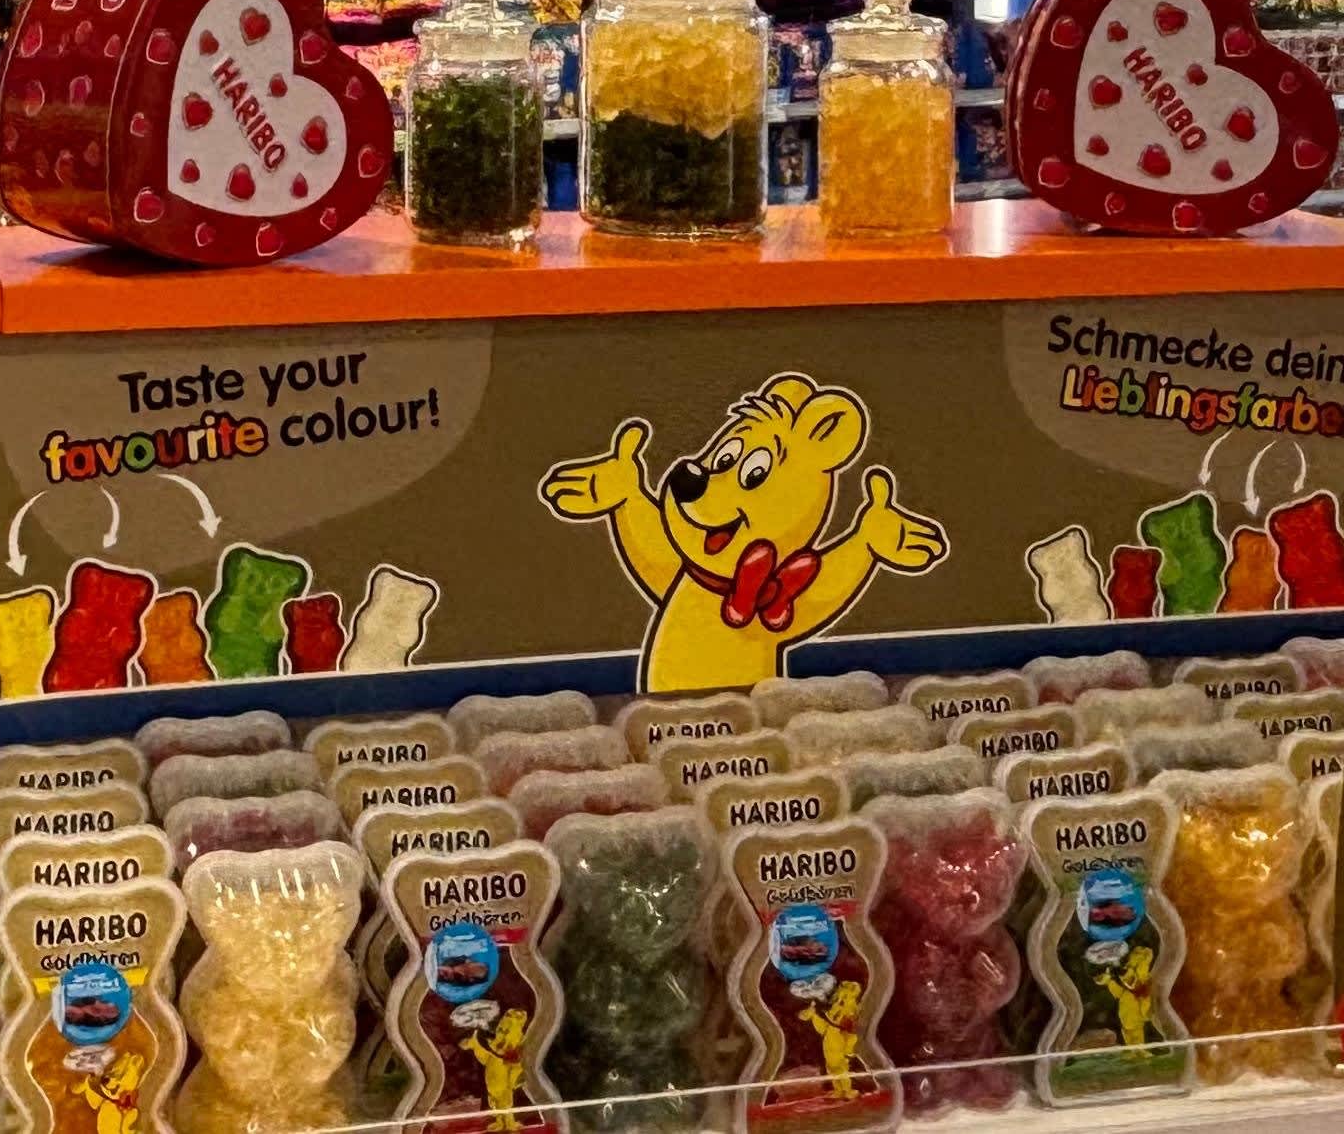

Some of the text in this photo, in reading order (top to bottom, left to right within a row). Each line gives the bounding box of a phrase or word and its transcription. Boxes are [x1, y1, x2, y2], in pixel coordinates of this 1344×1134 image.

[212, 55, 287, 172] HARIBO
[1122, 46, 1207, 152] HARIBO
[1047, 316, 1254, 373] Schmecke
[118, 352, 367, 413] Taste your
[39, 387, 440, 483] favourite colour!
[931, 697, 1011, 720] HARIBO
[338, 744, 427, 765] HARIBO
[981, 731, 1059, 758] HARIBO
[18, 769, 114, 790] HARIBO
[683, 757, 769, 785] HARIBO
[1029, 770, 1110, 800] HARIBO
[362, 785, 456, 809] HARIBO
[730, 797, 820, 826] HARIBO
[14, 811, 115, 835] HARIBO
[1056, 819, 1147, 851] HARIBO
[391, 829, 490, 858] HARIBO
[34, 858, 140, 887] HARIBO
[760, 849, 856, 881] HARIBO
[423, 873, 526, 906] HARIBO
[35, 912, 147, 946] HARIBO
